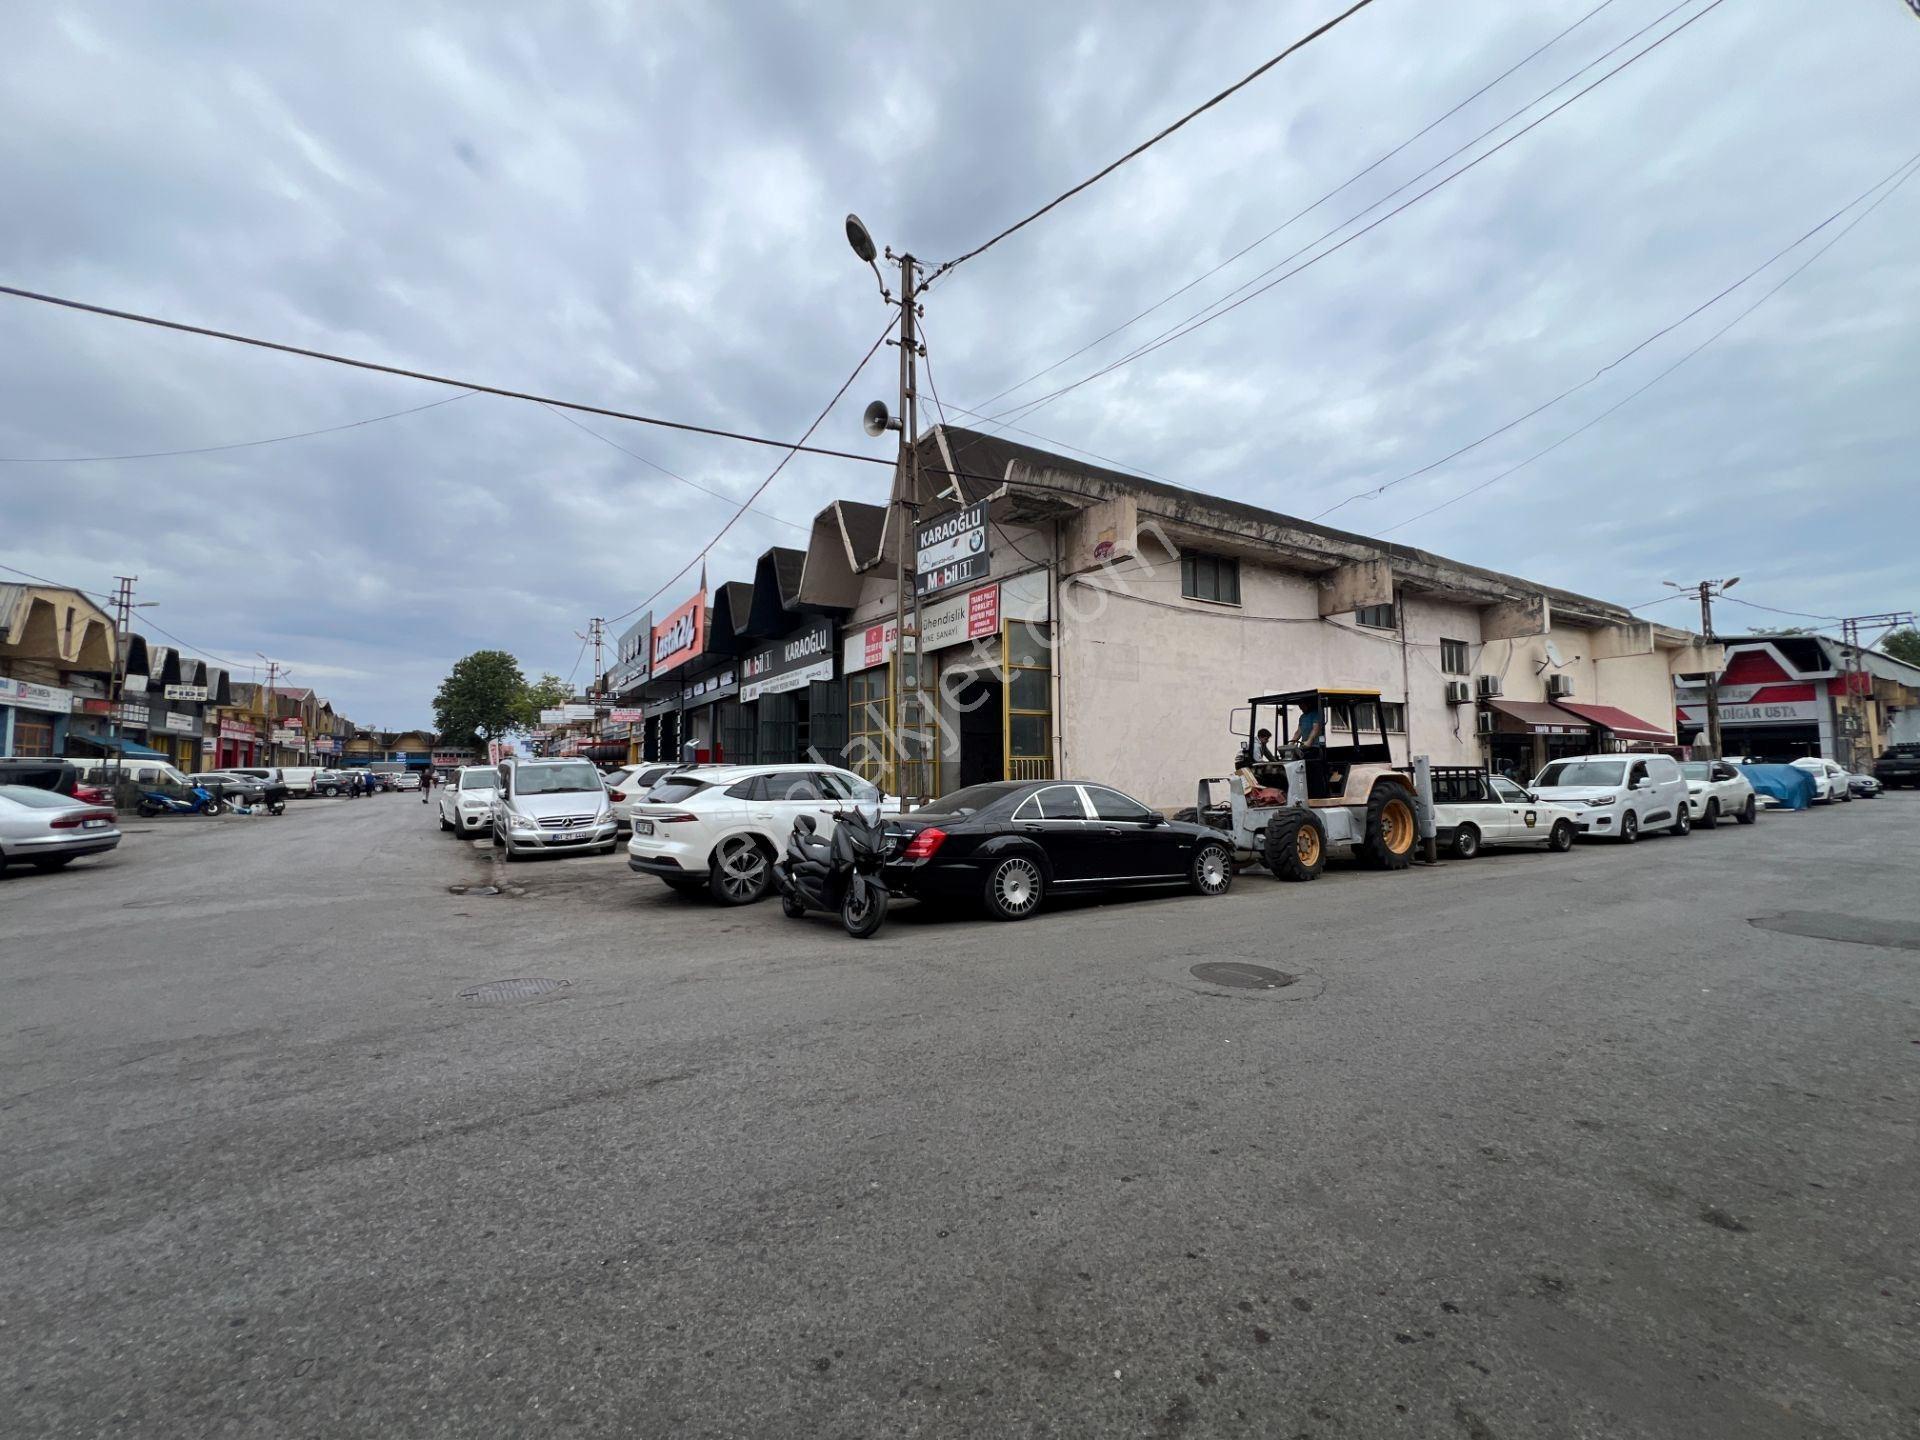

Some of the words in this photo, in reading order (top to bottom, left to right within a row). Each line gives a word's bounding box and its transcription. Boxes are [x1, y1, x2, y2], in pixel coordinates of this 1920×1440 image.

[920, 509, 981, 548] KARAOĞLU
[927, 564, 958, 590] Mobil
[922, 606, 966, 631] ühendislik
[784, 629, 827, 662] KARAOĞLU
[1765, 705, 1797, 718] USTA
